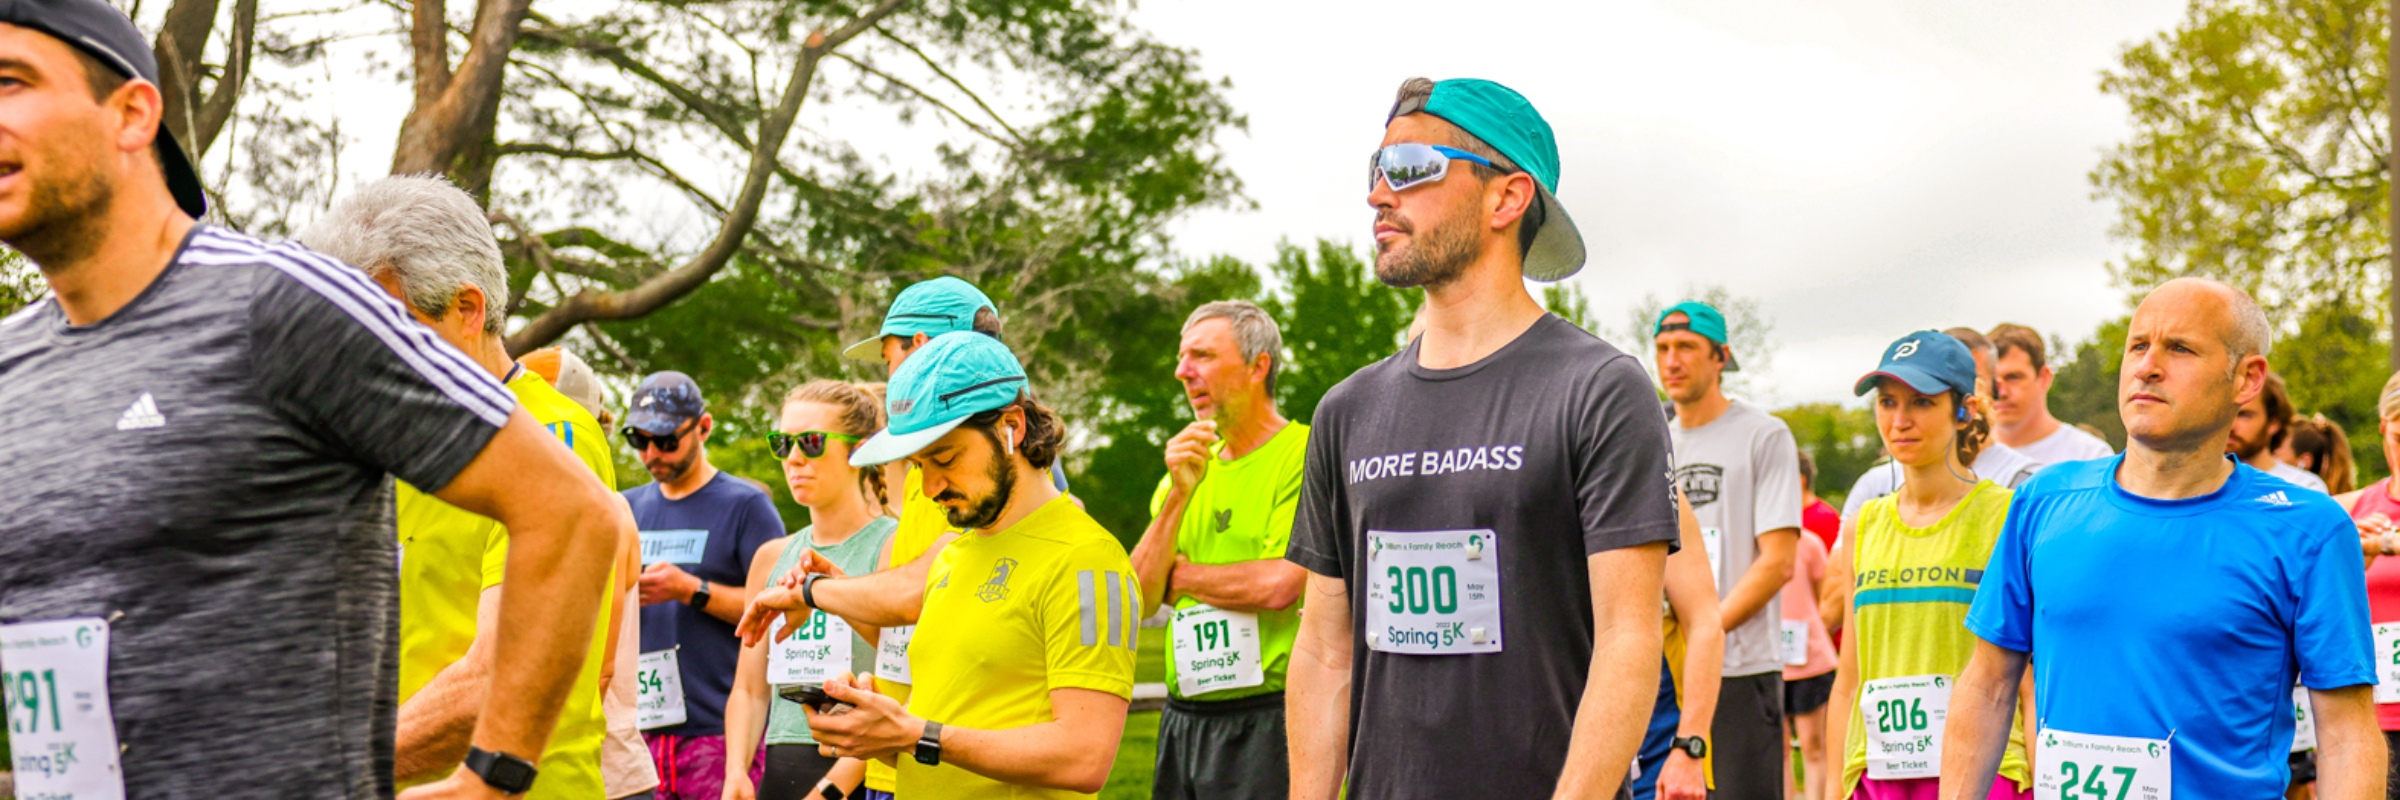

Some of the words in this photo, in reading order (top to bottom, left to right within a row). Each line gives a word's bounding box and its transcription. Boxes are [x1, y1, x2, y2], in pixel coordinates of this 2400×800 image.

[1349, 452, 1416, 485] MORE
[1420, 446, 1523, 475] BADASS
[1409, 543, 1434, 551] Family
[1435, 541, 1463, 550] Reach
[1866, 566, 1960, 585] PELOTON
[1387, 565, 1458, 615] 300
[792, 609, 827, 641] 28
[1193, 619, 1230, 652] 191
[1388, 626, 1438, 649] Spring
[1442, 622, 1465, 646] 5K
[785, 647, 815, 661] Spring
[817, 644, 831, 660] 5K
[1191, 657, 1224, 672] Spring
[1226, 650, 1241, 667] 5K
[637, 668, 662, 695] 54
[803, 666, 825, 675] Ticket
[1213, 673, 1237, 682] Ticket
[1877, 697, 1928, 734] 206
[1881, 740, 1914, 755] Spring
[1917, 734, 1933, 753] 5K
[2091, 743, 2114, 753] Family
[2116, 744, 2142, 754] Reach
[1901, 761, 1928, 769] Ticket
[2061, 761, 2138, 800] 247
